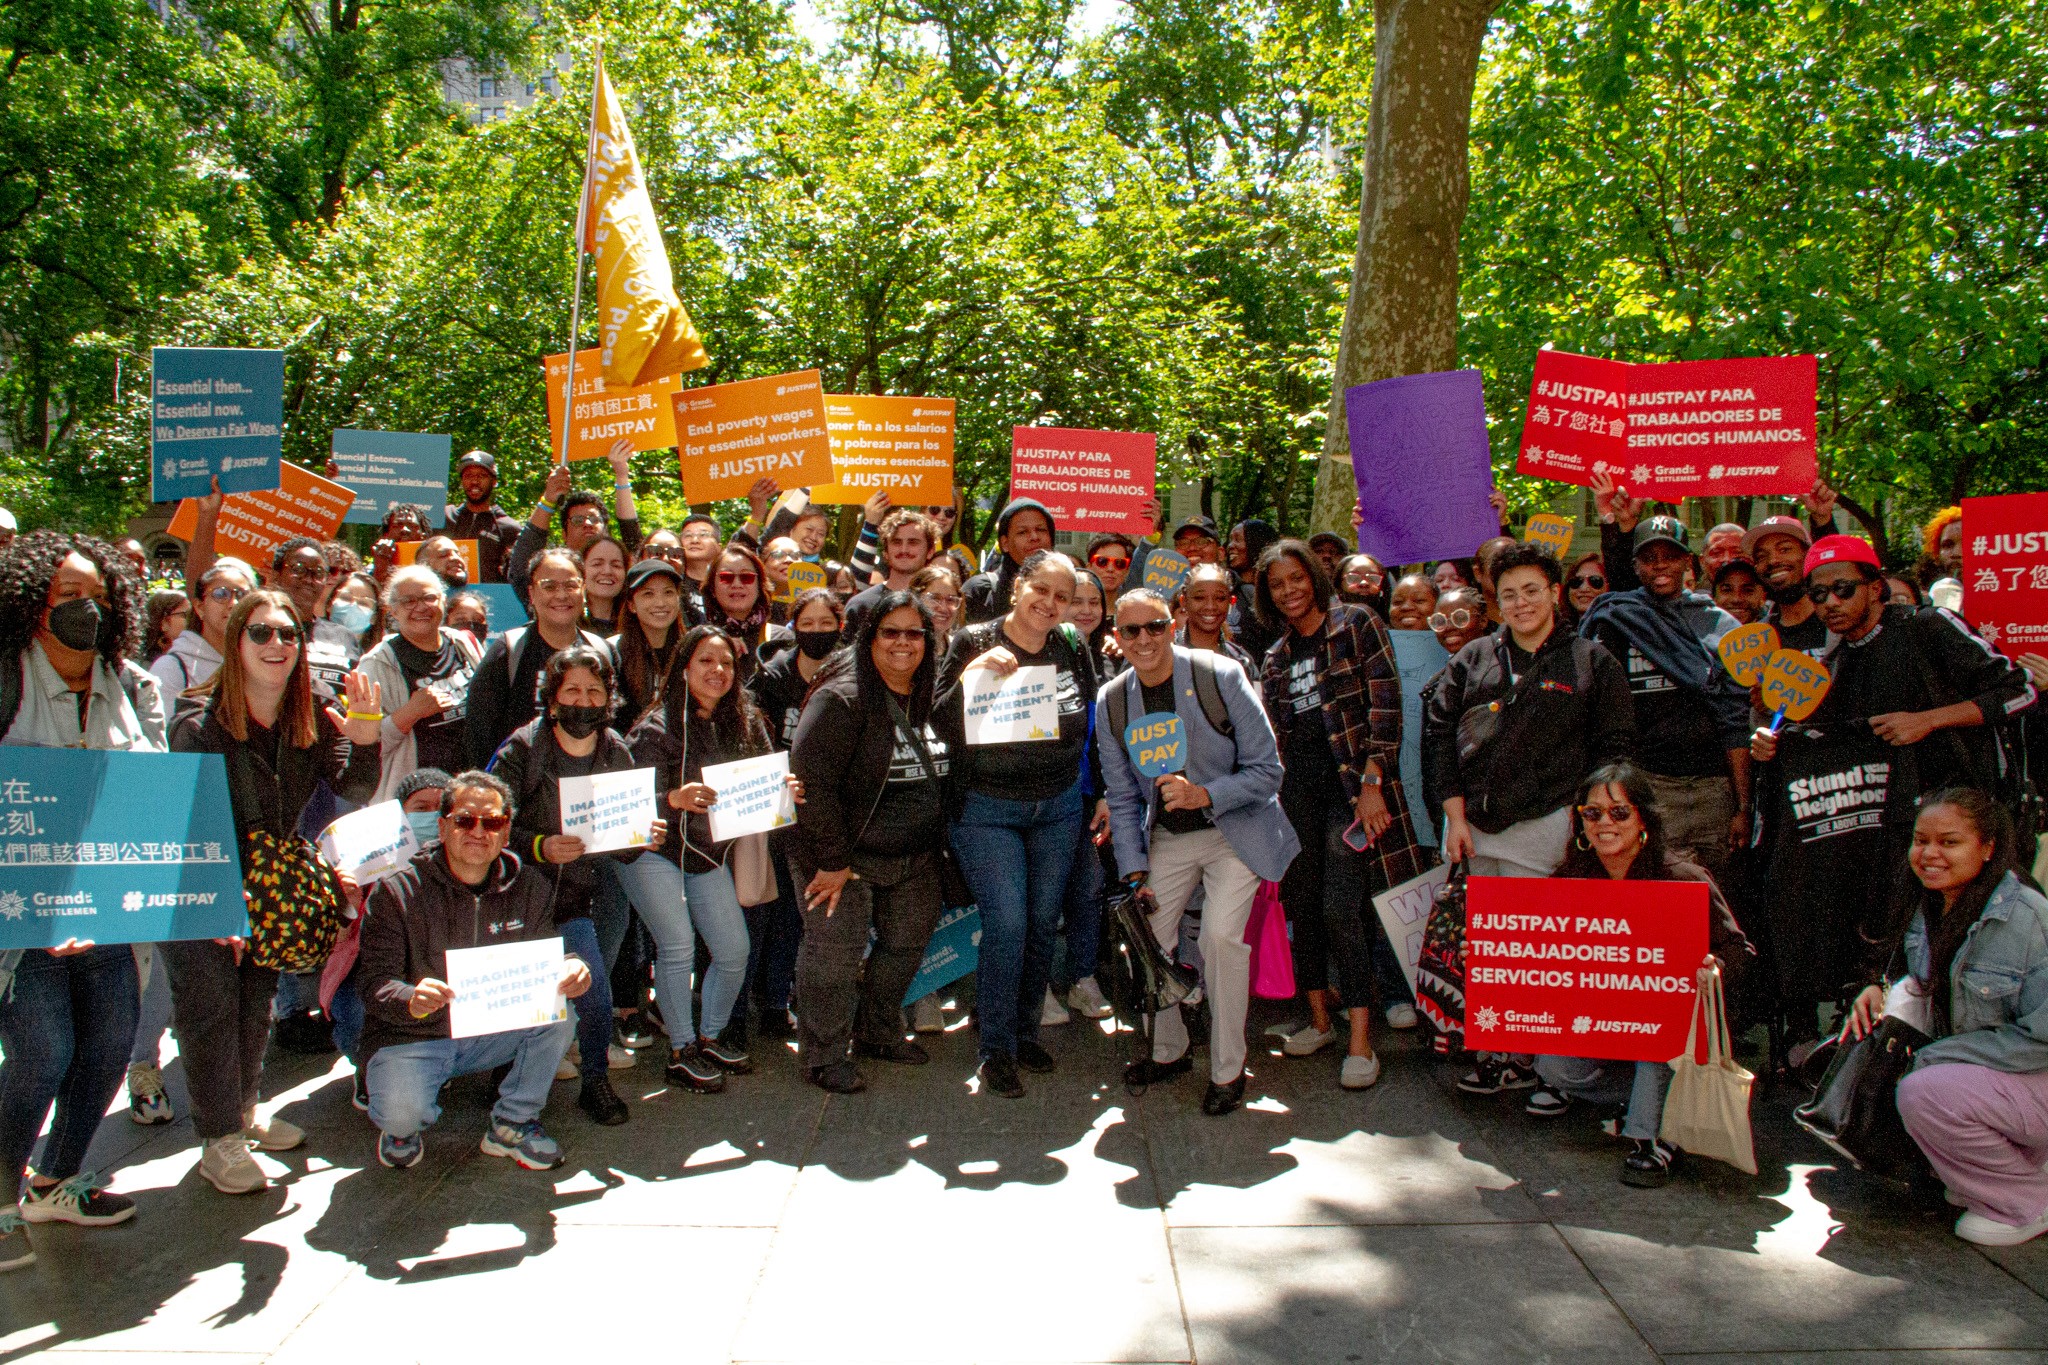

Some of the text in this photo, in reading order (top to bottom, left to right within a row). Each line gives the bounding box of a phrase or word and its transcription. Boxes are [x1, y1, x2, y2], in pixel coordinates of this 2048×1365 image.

[156, 378, 253, 396] Essential then...
[1627, 388, 1756, 406] #JUSTPAY PARA
[156, 400, 244, 419] Essential now.
[1627, 408, 1782, 427] TRABAJADORES DE
[580, 417, 657, 441] #JUSTPAY
[687, 408, 815, 437] End poverty wages
[827, 420, 947, 434] oner fin a los salarios
[1532, 404, 1626, 438] 為了您社會
[156, 422, 279, 440] We Deserve a Fair Wage.
[1627, 428, 1807, 448] SERVICIOS HUMANOS.
[684, 426, 826, 457] for essential workers.
[844, 437, 892, 451] pobreza
[894, 440, 921, 452] para
[923, 439, 940, 451] los
[333, 451, 367, 462] Esencial
[708, 449, 806, 480] #JUSTPAY
[889, 456, 951, 468] esenciales.
[1016, 448, 1112, 463] #JUSTPAY PARA
[338, 464, 397, 475] sencial Ahora.
[1015, 463, 1131, 480] TRABAJADORES DE
[841, 472, 924, 488] #JUSTPAY
[1014, 479, 1149, 497] SERVICIOS HUMANOS.
[275, 487, 338, 521] los salarios
[276, 508, 305, 526] para
[305, 517, 324, 533] los
[1528, 520, 1571, 537] JUST
[1147, 554, 1189, 574] JUST
[790, 569, 824, 584] JUST
[1145, 571, 1179, 589] PAY
[1724, 627, 1773, 658] JUST
[1735, 650, 1774, 676] PAY
[1772, 656, 1828, 690] JUST
[973, 685, 1029, 704] IMAGINE
[1031, 683, 1045, 693] IF
[1767, 679, 1812, 707] PAY
[967, 705, 989, 717] WE
[990, 694, 1054, 712] WEREN'T
[993, 710, 1031, 724] HERE
[1129, 717, 1180, 746] JUST
[1140, 741, 1180, 766] PAY
[717, 770, 782, 799] MAGINE IF
[1788, 765, 1864, 802] Stand
[569, 786, 643, 814] IMAGINE IF
[710, 800, 732, 812] WE
[736, 799, 772, 817] HERE
[564, 796, 651, 827] WE WEREN'T
[591, 815, 630, 833] HERE
[1832, 815, 1859, 831] ABOVE
[1859, 812, 1880, 825] HATE
[32, 890, 85, 906] Grand
[36, 907, 98, 917] SETTLEMEN
[1471, 913, 1632, 935] #JUSTPAY PARA
[1470, 940, 1665, 964] TRABAJADORES DE
[460, 960, 550, 989] IMAGINE IF
[1471, 967, 1697, 994] SERVICIOS HUMANOS.
[454, 972, 560, 1004] WE WEREN'T
[486, 992, 533, 1010] HERE
[1504, 1009, 1549, 1024] Grand
[1505, 1023, 1563, 1035] SETTLEMENT
